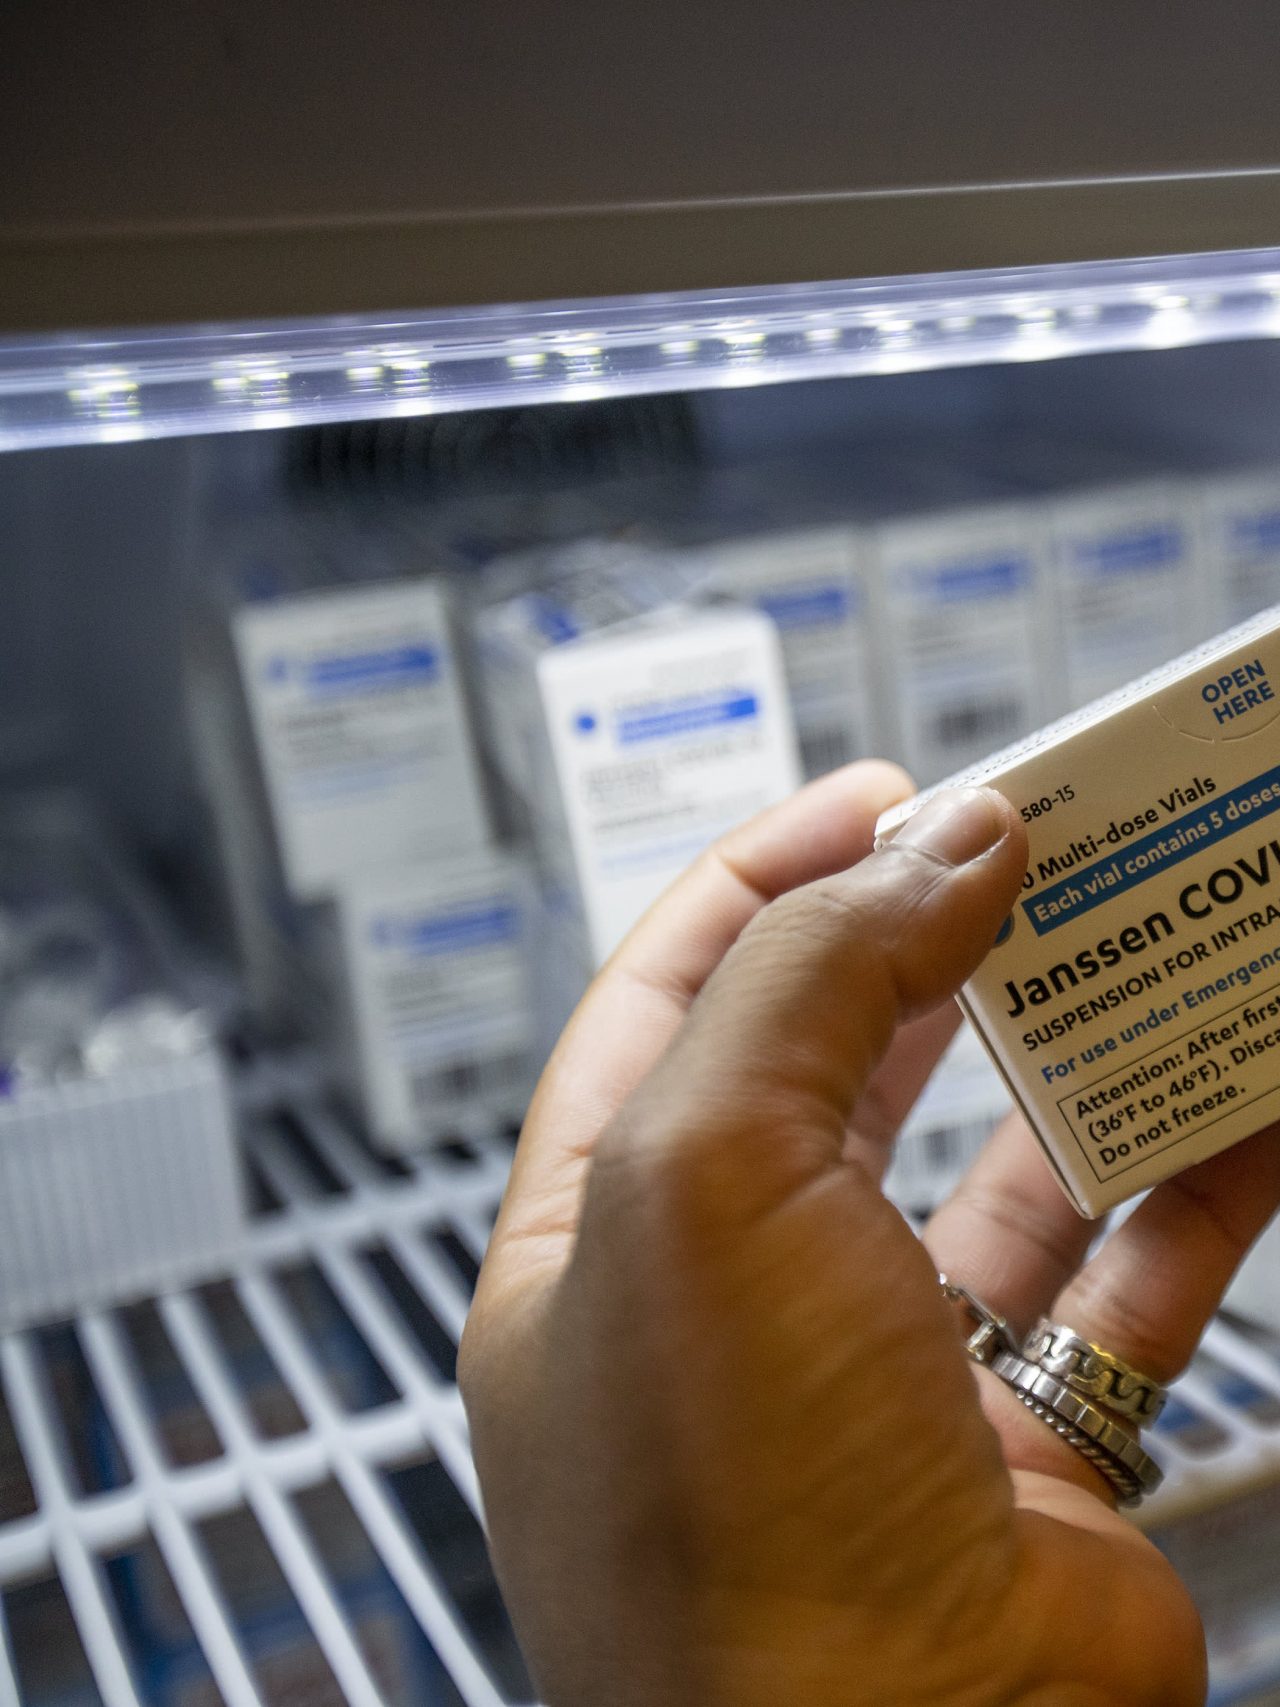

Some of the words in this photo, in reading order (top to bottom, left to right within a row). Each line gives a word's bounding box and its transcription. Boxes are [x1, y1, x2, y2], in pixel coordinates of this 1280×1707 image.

[1201, 659, 1266, 703] OPEN
[1212, 681, 1275, 725] HERE
[1034, 881, 1084, 923] Each
[1084, 863, 1121, 895] vial
[1125, 822, 1209, 875] contains
[1210, 811, 1223, 830] 5
[1037, 807, 1160, 882] Multi-dose
[1158, 774, 1217, 813] Vials
[1004, 912, 1175, 1018] Janssen
[1023, 967, 1162, 1051] SUSPENSION
[1163, 943, 1212, 976] FOR
[1041, 1057, 1076, 1084] For
[1081, 1038, 1118, 1065] use
[1121, 1002, 1180, 1043] under
[1076, 1052, 1183, 1119] Attention:
[1188, 1022, 1240, 1061] After
[1087, 1104, 1140, 1143] (36°F
[1140, 1094, 1165, 1113] to
[1099, 1142, 1131, 1166] Do
[1134, 1120, 1171, 1148] not
[1171, 1083, 1246, 1126] freeze.
